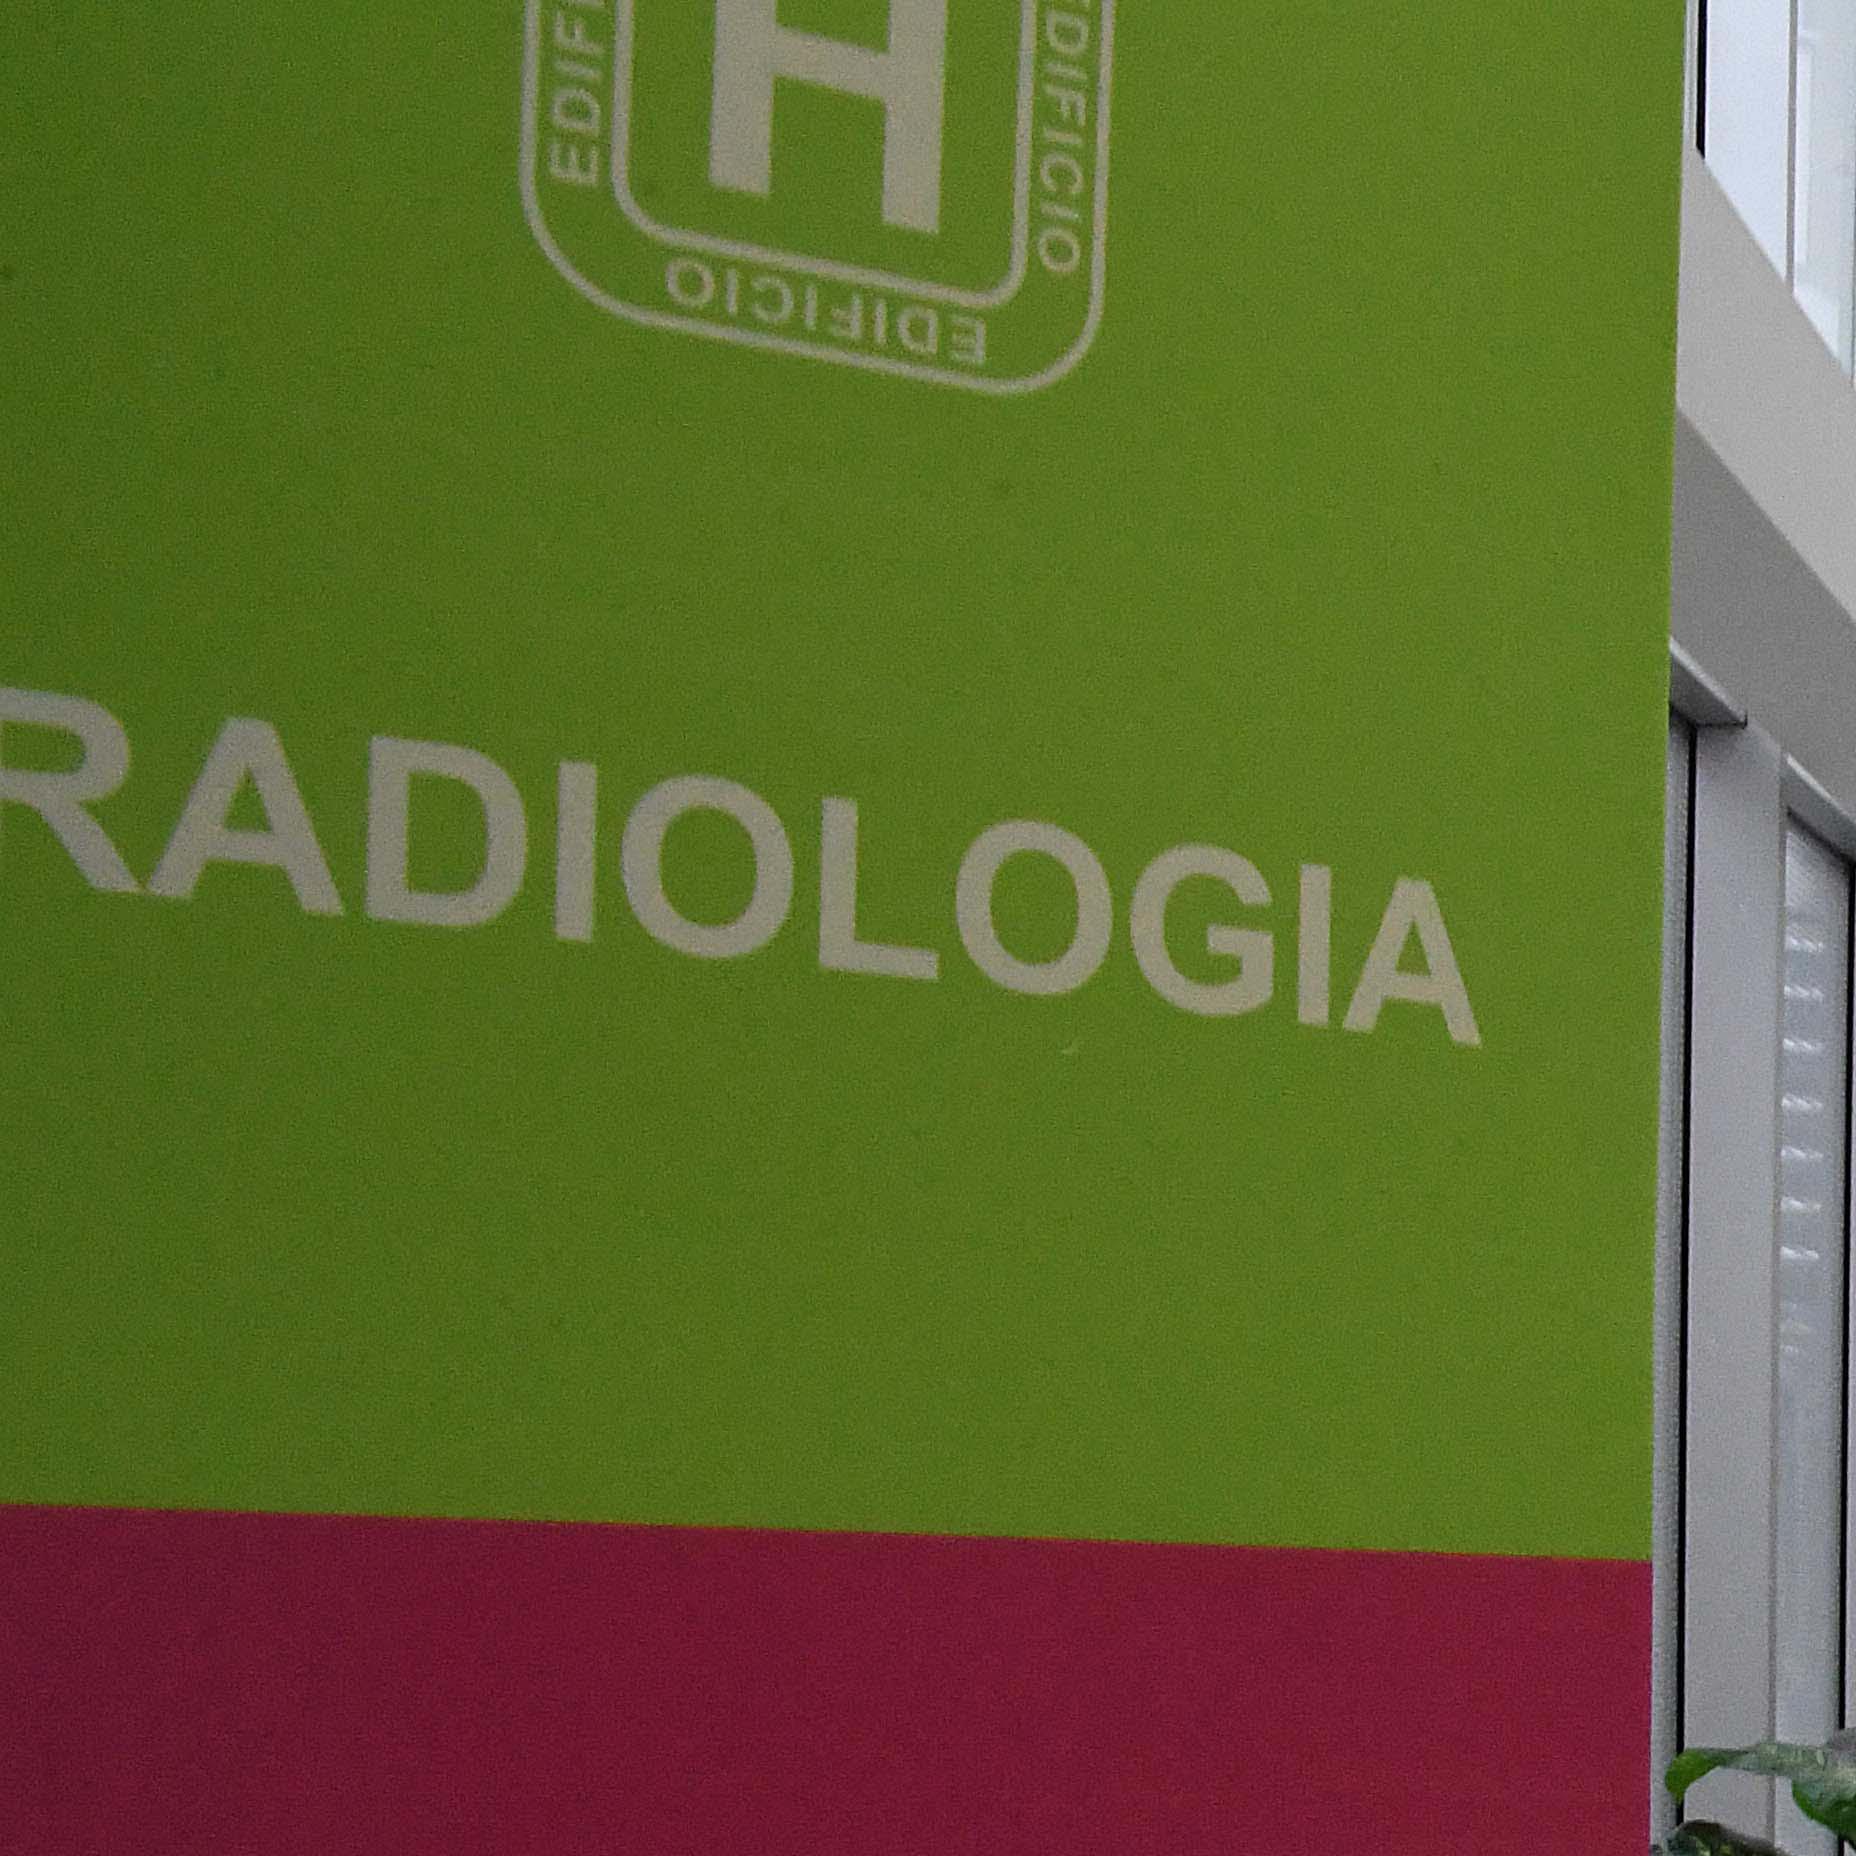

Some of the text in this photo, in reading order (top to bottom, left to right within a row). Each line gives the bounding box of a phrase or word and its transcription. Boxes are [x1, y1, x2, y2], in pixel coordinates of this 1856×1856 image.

[708, 0, 948, 234] H
[1036, 0, 1089, 274] DIFICIO
[665, 257, 987, 364] EDIFICIO
[0, 687, 1482, 1047] RADIOLOGIA
